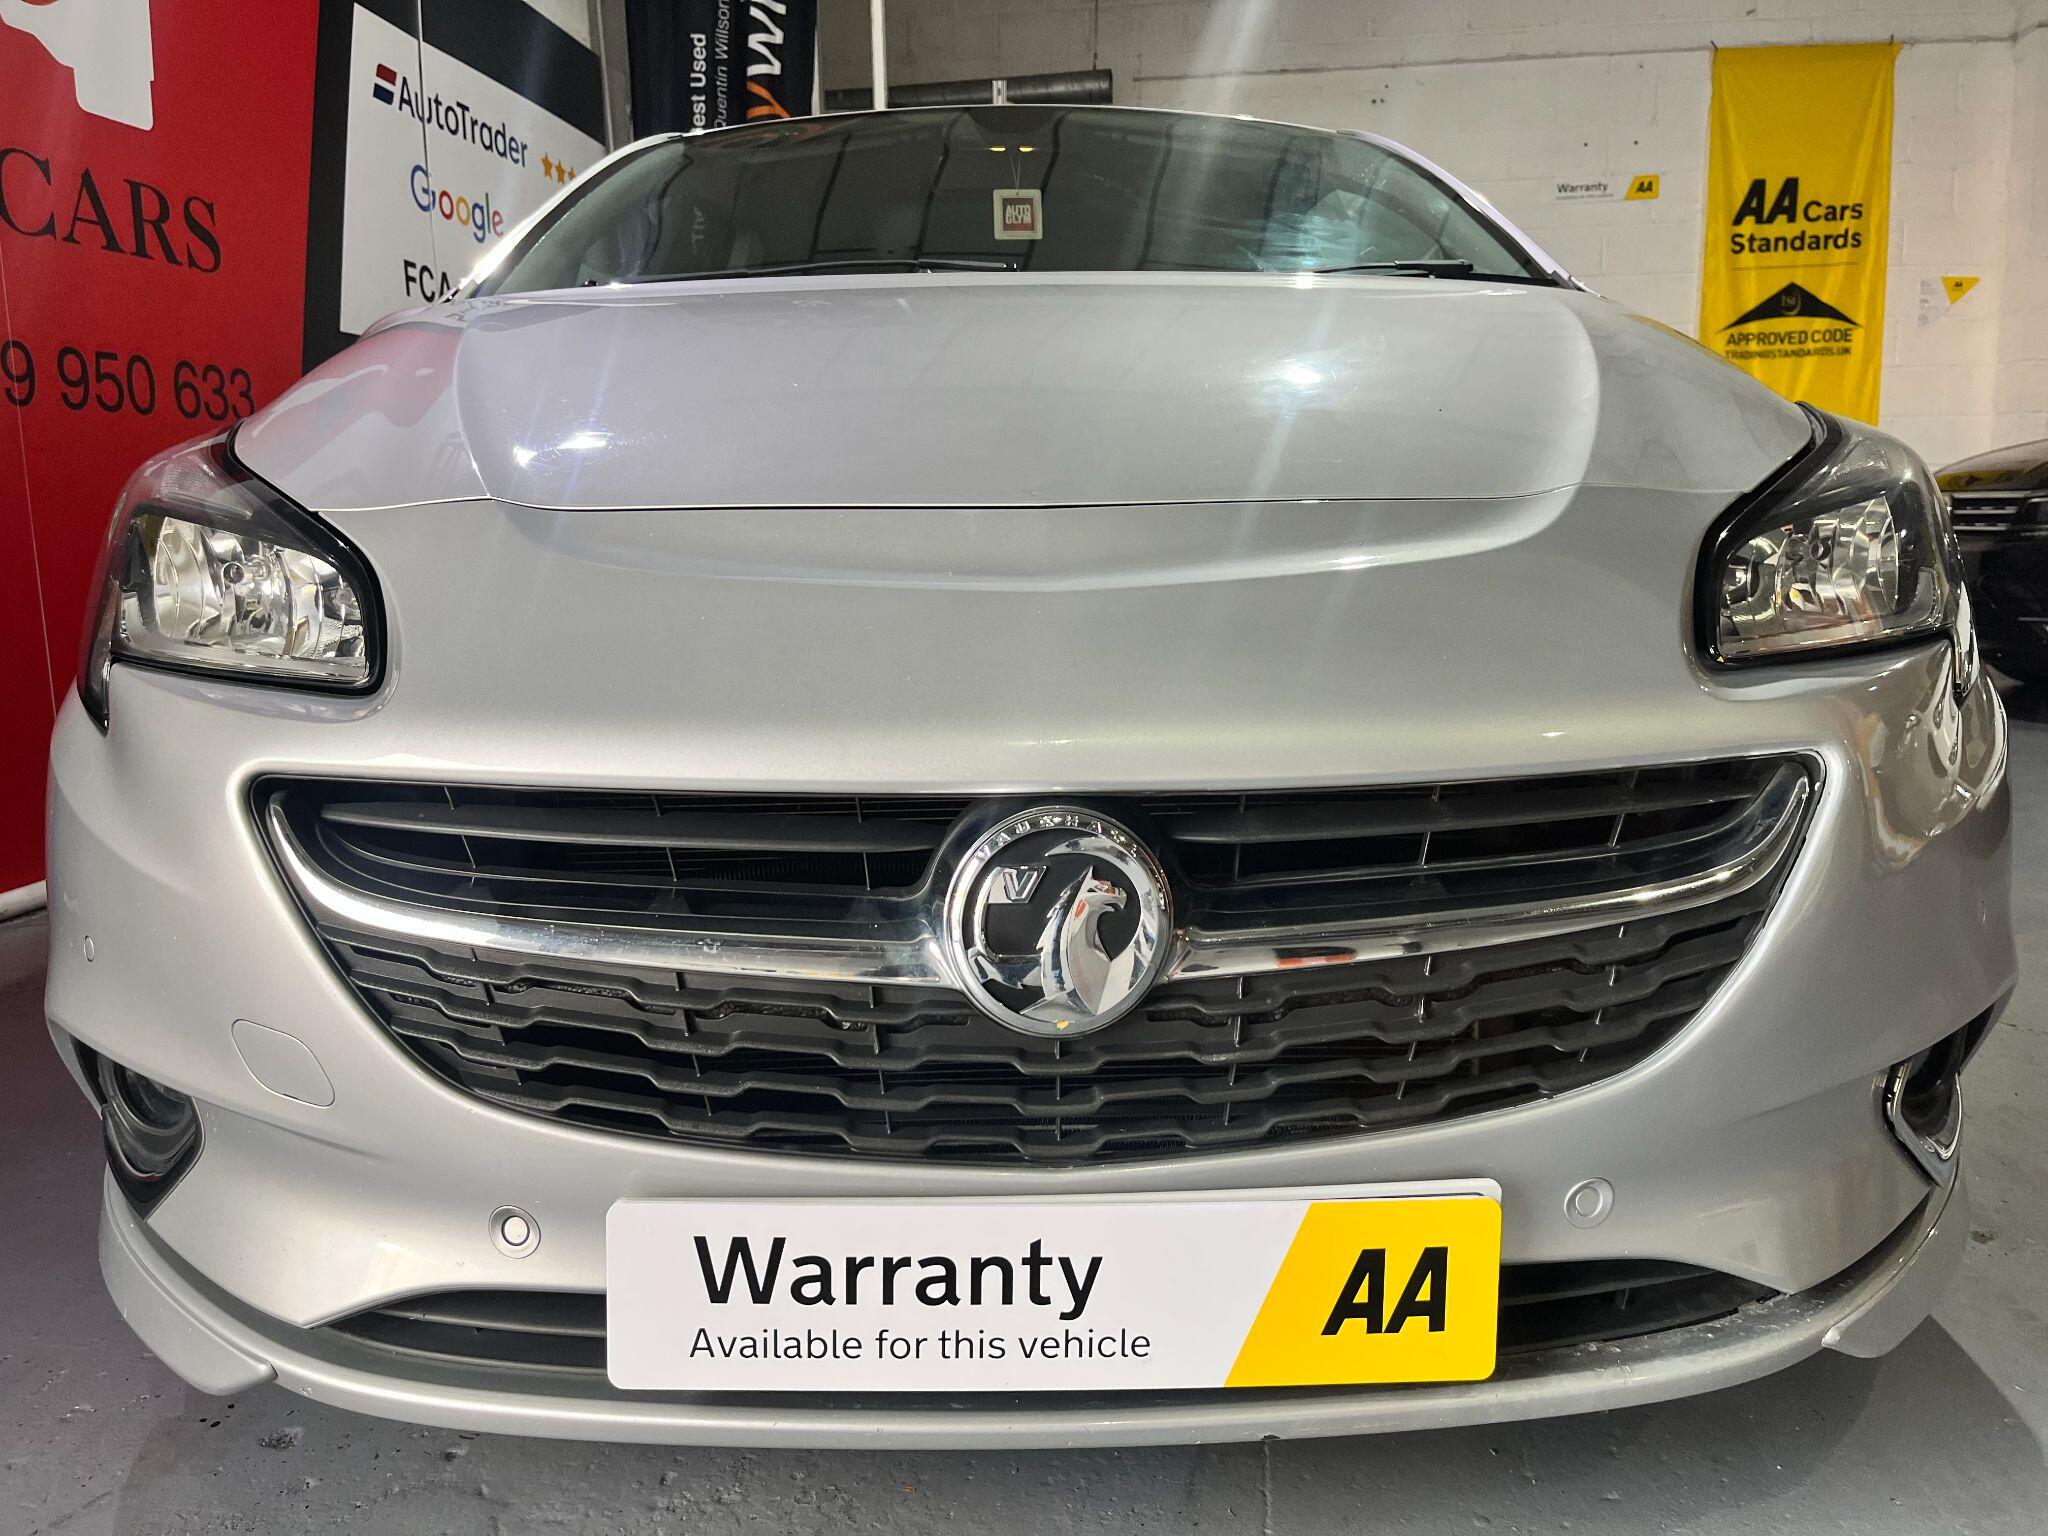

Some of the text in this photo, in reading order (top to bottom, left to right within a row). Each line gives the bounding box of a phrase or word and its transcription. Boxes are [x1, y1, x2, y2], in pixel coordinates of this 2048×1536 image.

[689, 32, 706, 88] Used
[398, 76, 529, 168] AutoTrader
[690, 94, 706, 131] est
[0, 147, 222, 273] CARS
[410, 164, 504, 244] Google
[1006, 205, 1031, 215] AUTO
[1556, 181, 1654, 193] Warranty AA
[1732, 176, 1863, 226] AA Cars
[1730, 227, 1863, 254] Standards
[1726, 328, 1853, 346] APPROVED CODE
[57, 345, 156, 416] 950
[173, 359, 257, 421] 633
[693, 1235, 1103, 1321] Warranty
[1321, 1247, 1449, 1336] AA
[689, 1327, 1151, 1360] Available for this vehicle
